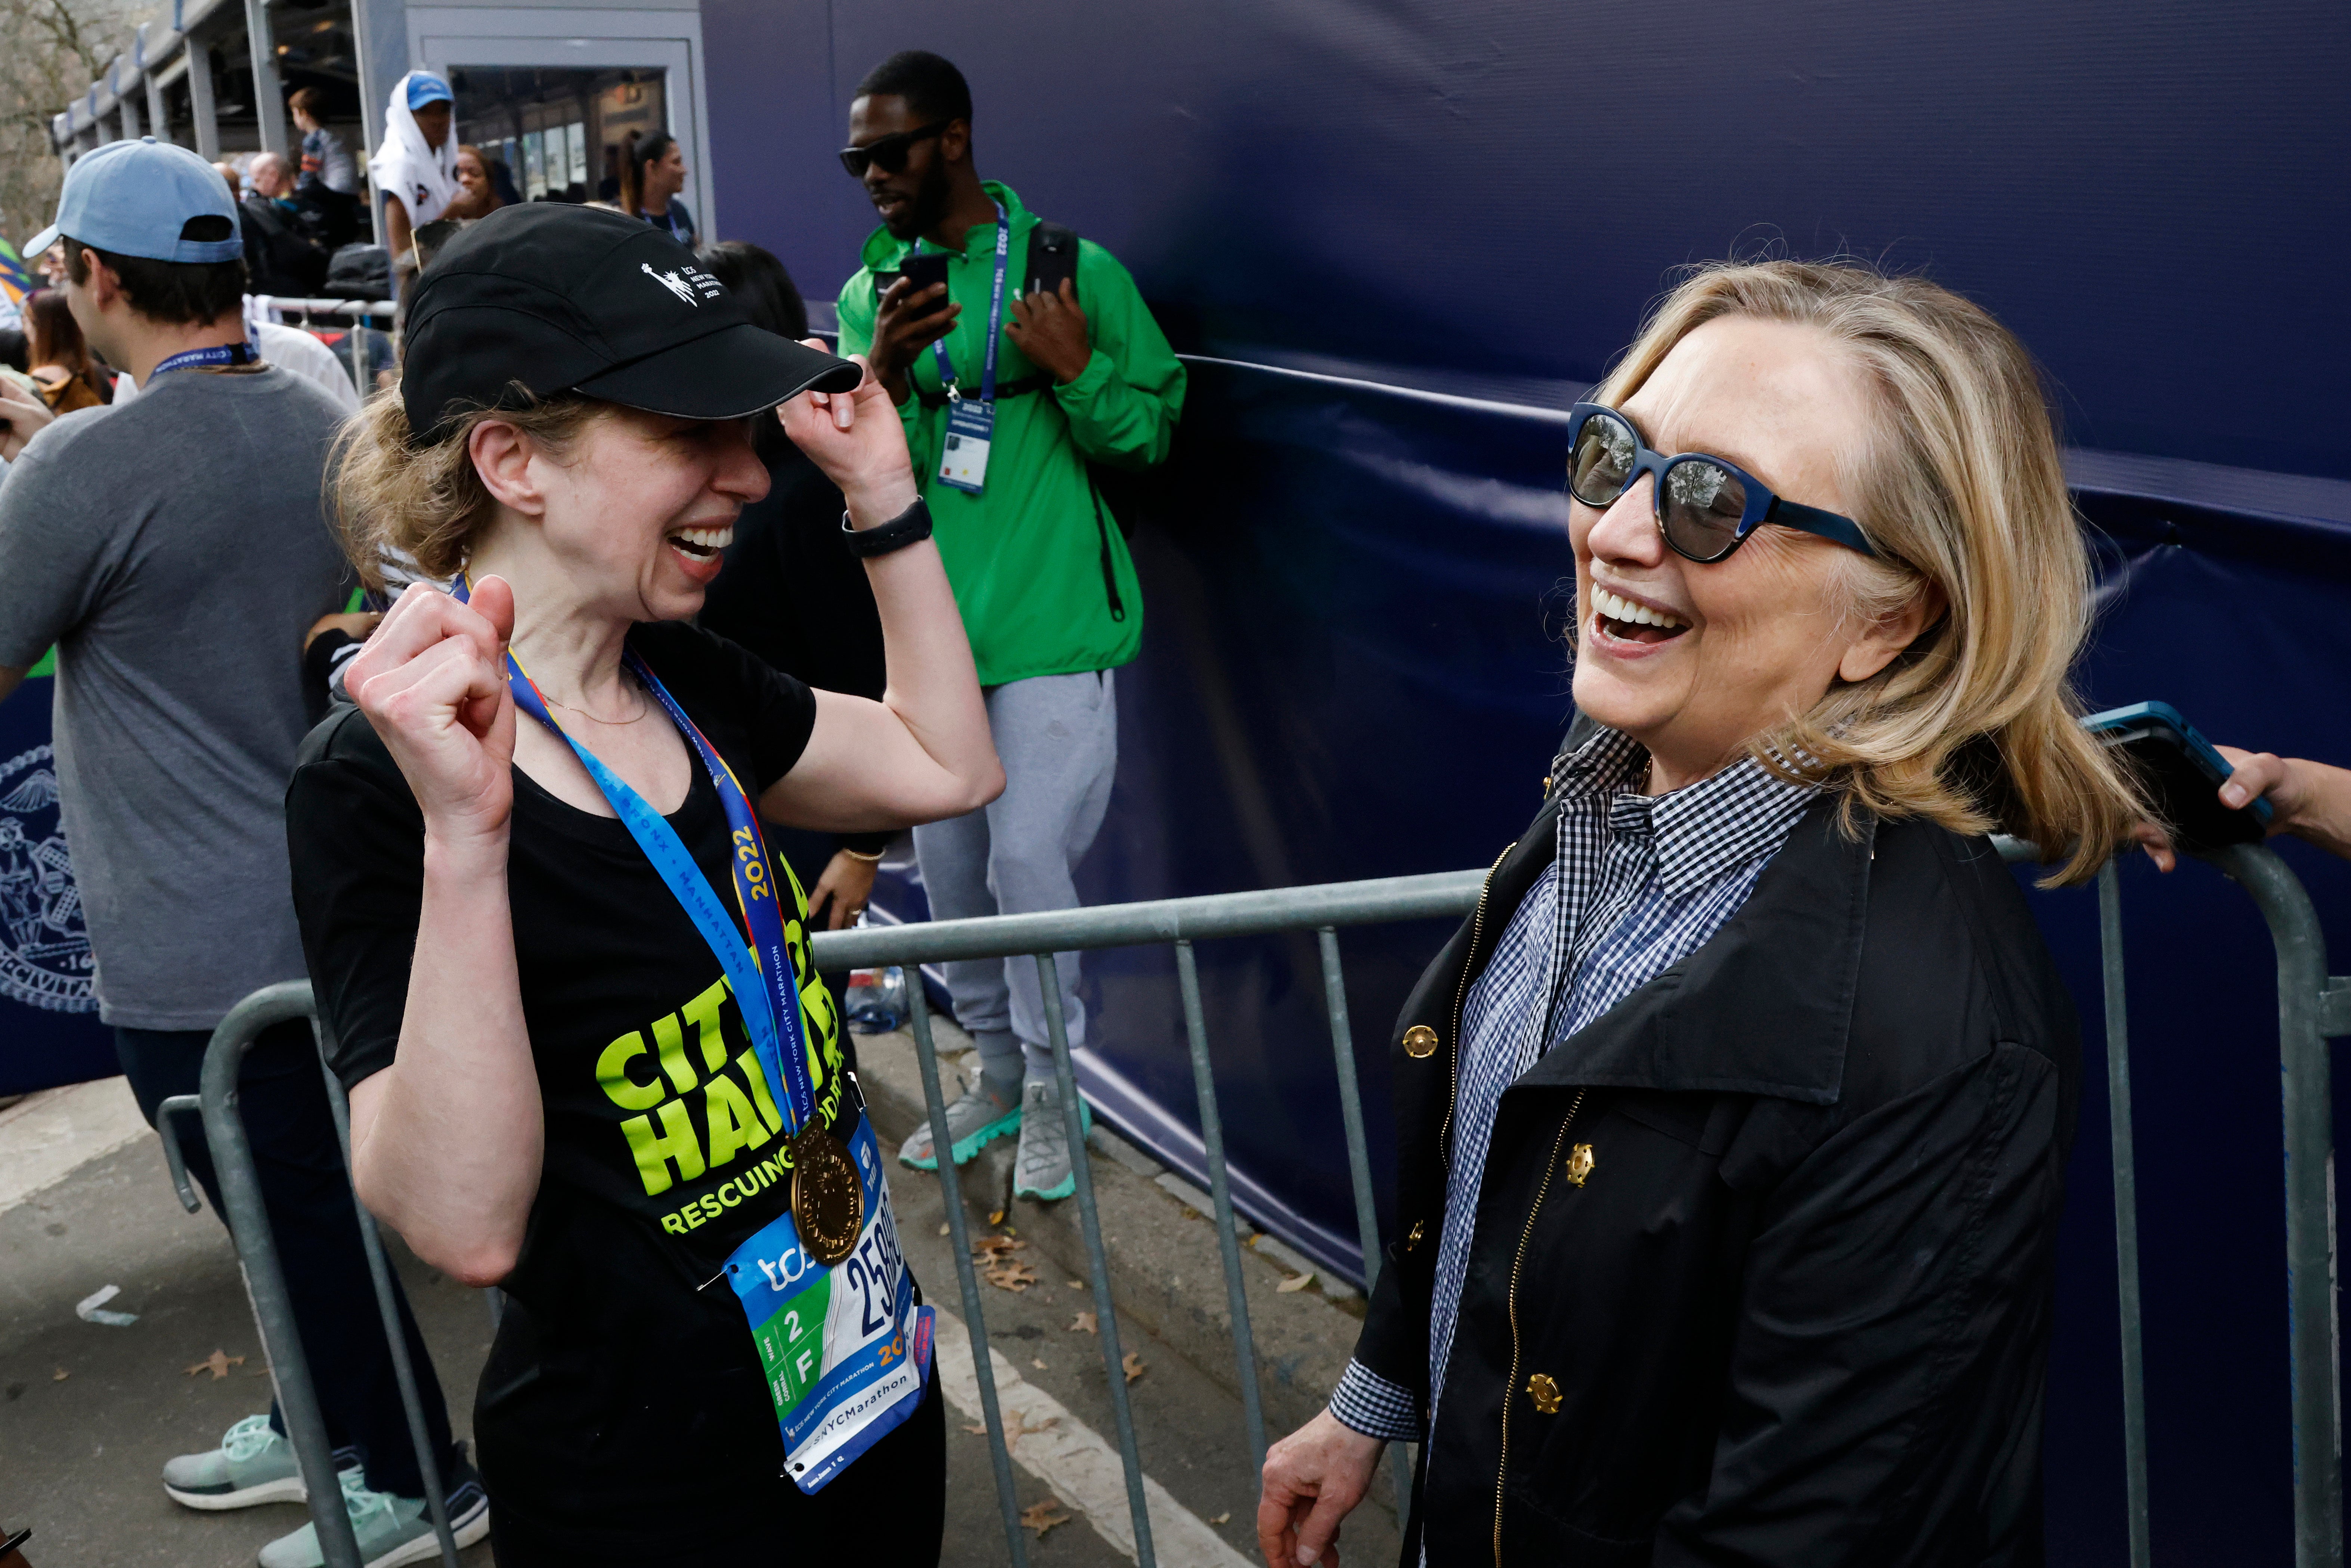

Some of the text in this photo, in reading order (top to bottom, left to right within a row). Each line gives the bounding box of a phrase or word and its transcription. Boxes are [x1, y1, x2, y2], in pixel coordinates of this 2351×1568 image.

[690, 274, 705, 282] NEW
[704, 289, 720, 298] 2022
[732, 825, 769, 901] 2022
[622, 797, 670, 852] BRONX
[679, 871, 744, 974] MANHATTAN
[12, 964, 92, 997] CIVITA
[772, 945, 787, 1005] MARATHON
[783, 1009, 792, 1032] CITY
[789, 1034, 799, 1063] YORK
[796, 1066, 805, 1090] NEW
[661, 1144, 796, 1235] RESCUING
[784, 1310, 803, 1343] 2
[763, 1336, 774, 1362] WAVE
[796, 1349, 813, 1384] F
[815, 1397, 827, 1410] YORK
[827, 1385, 839, 1397] CITY
[840, 1361, 875, 1386] MARATHON
[878, 1334, 904, 1367] 20
[773, 1380, 783, 1406] GREEN
[779, 1370, 790, 1402] CORRAL
